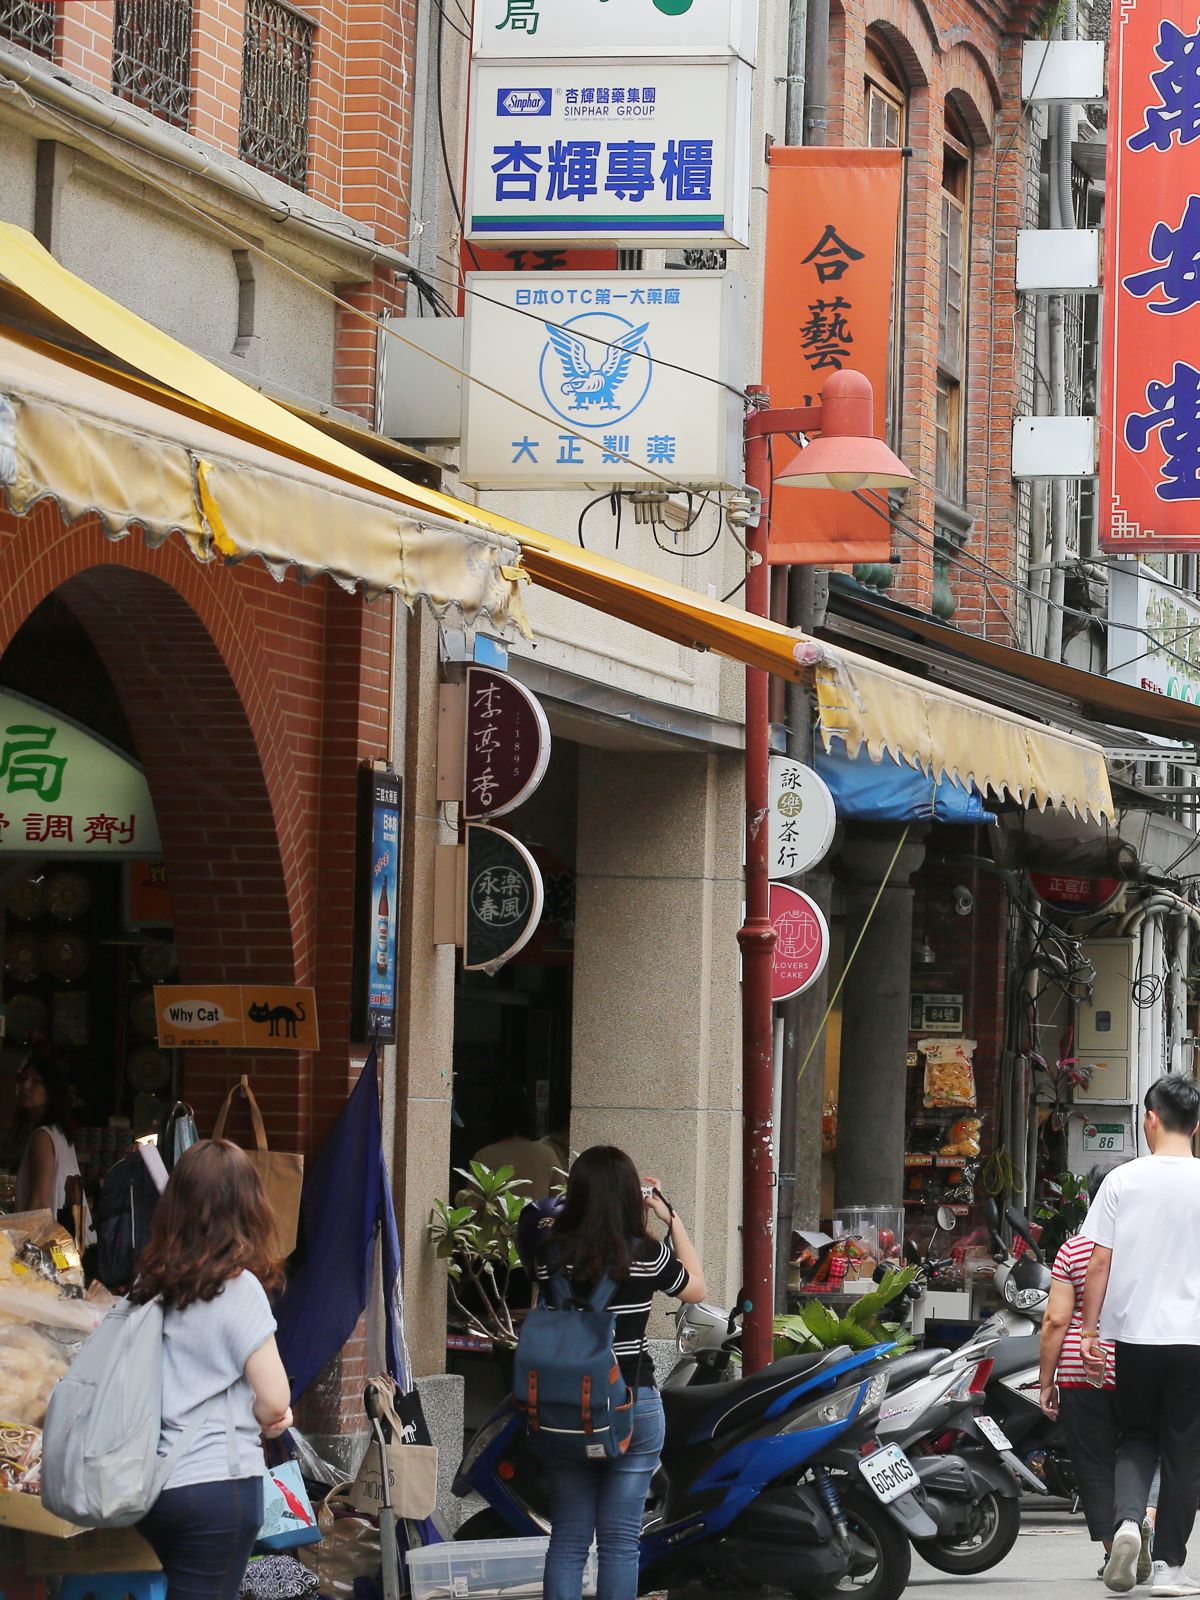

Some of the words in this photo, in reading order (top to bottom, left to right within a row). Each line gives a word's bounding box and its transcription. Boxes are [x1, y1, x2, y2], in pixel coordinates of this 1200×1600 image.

[508, 94, 542, 112] Sinphar
[565, 87, 656, 104] 杏輝醫藥集團
[564, 106, 609, 116] SINPHAR
[616, 106, 655, 116] GROUP
[491, 140, 713, 202] 杏輝專櫃
[801, 224, 866, 408] 合藝
[0, 725, 68, 802] 局
[777, 768, 803, 868] 詠樂茶行
[169, 1008, 193, 1022] Why
[197, 1007, 219, 1021] Cat
[1099, 1137, 1114, 1149] 86
